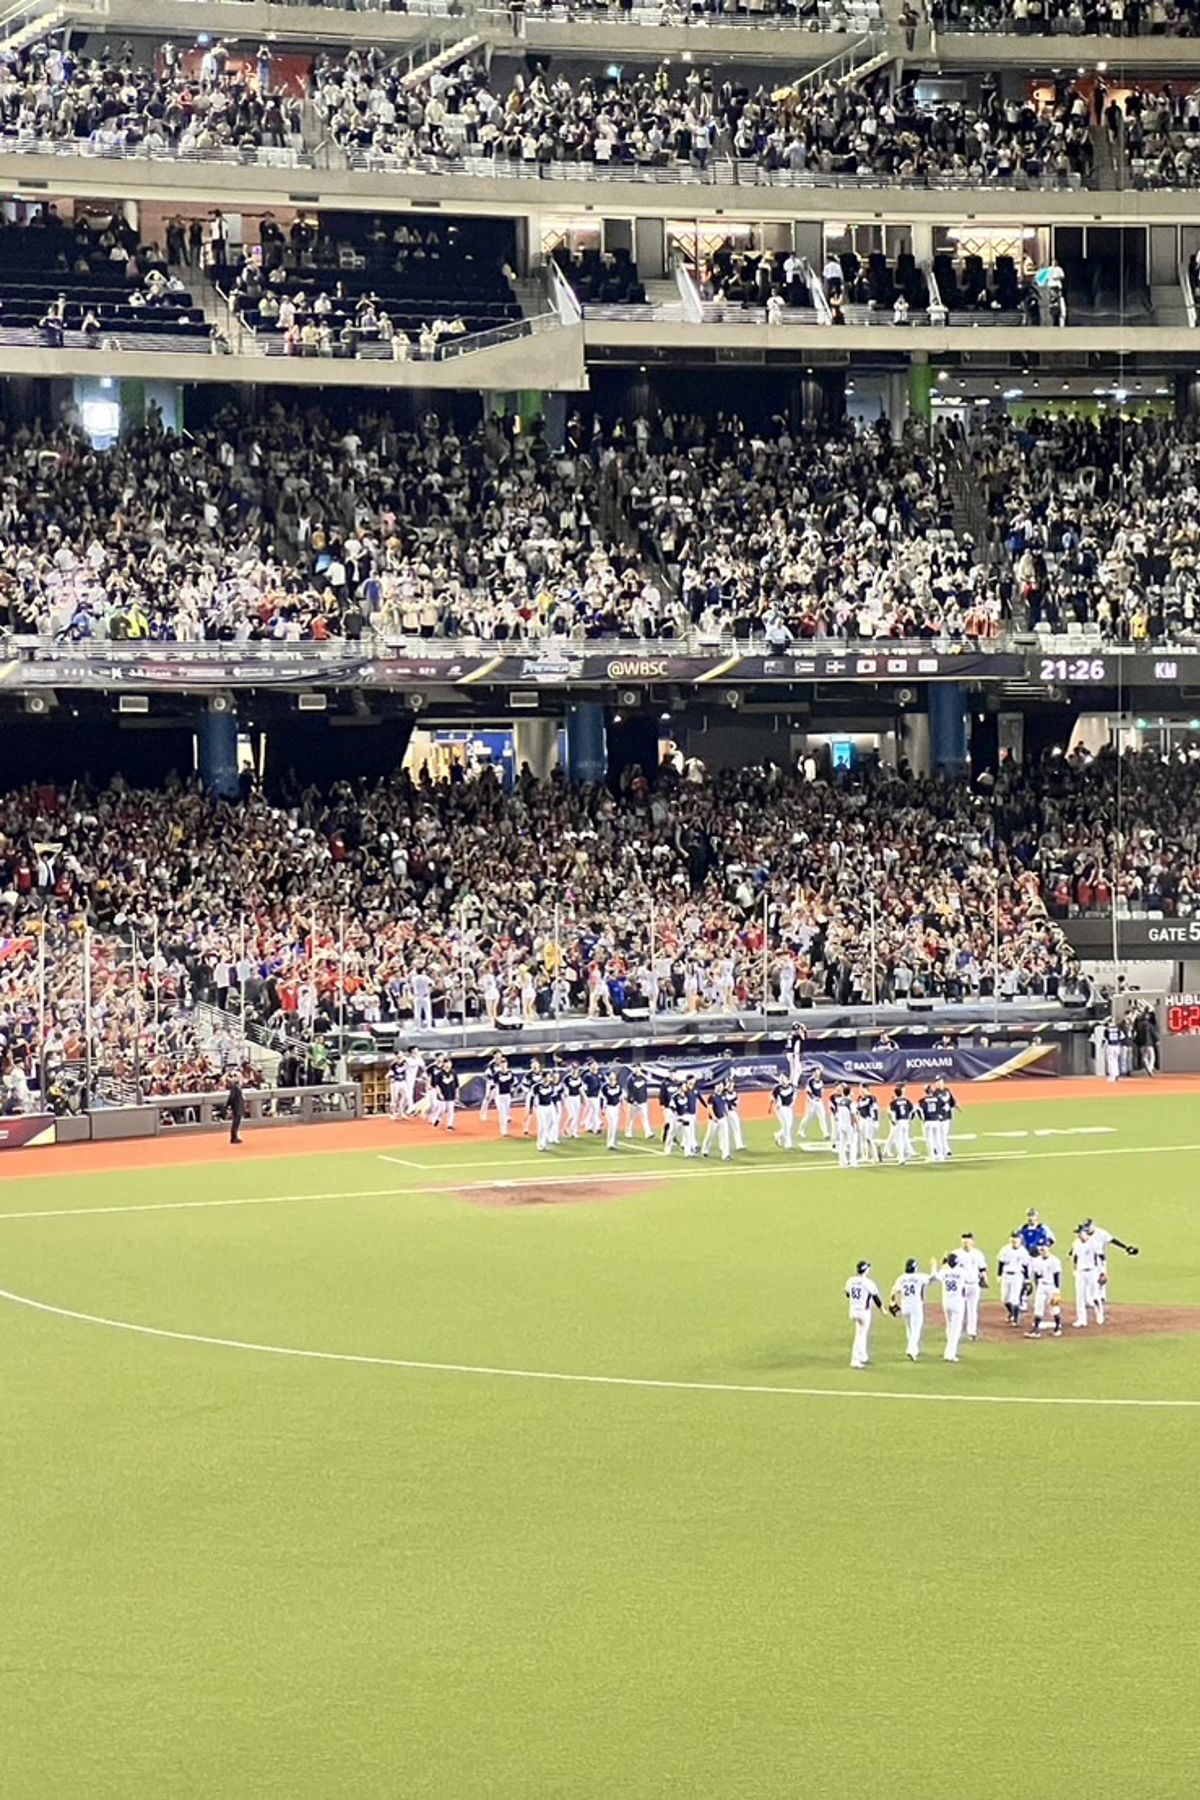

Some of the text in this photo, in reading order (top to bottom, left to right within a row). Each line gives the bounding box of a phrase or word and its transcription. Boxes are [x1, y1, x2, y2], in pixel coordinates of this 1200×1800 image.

[607, 660, 668, 679] @WBSC
[1040, 660, 1104, 680] 21:26
[1155, 662, 1177, 678] KM
[1149, 928, 1186, 941] GATE
[906, 1057, 953, 1069] KONAMI
[903, 1284, 916, 1296] 24
